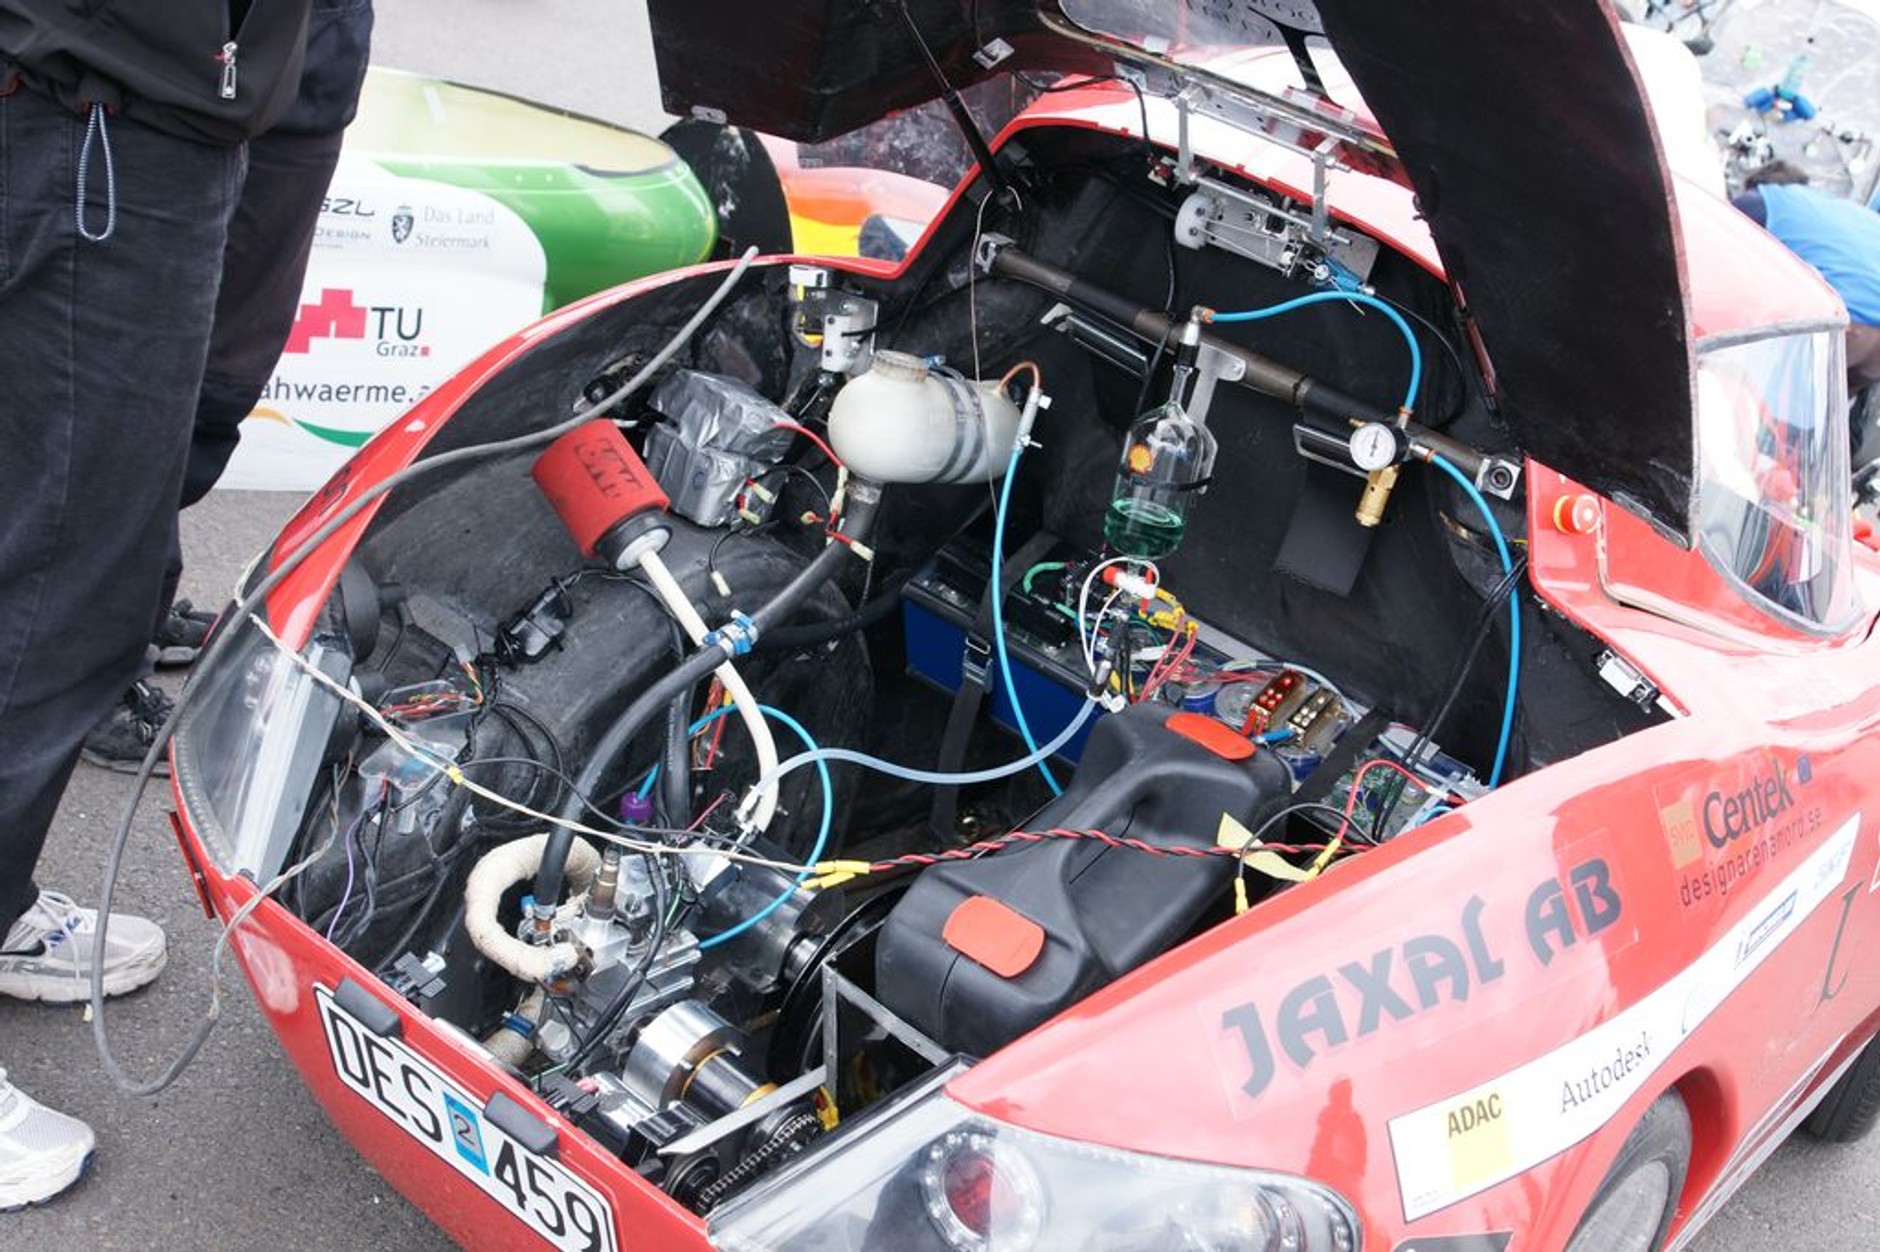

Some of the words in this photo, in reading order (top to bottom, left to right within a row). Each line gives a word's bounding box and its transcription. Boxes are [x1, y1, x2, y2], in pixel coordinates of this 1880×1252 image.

[424, 206, 451, 223] Das
[457, 208, 495, 225] Land
[415, 233, 490, 250] Steiermark
[371, 307, 422, 341] TU
[376, 341, 419, 357] Graz
[1703, 757, 1795, 848] Centek
[1222, 894, 1504, 1098] JAXAL
[1524, 857, 1622, 967] AB
[1560, 1031, 1651, 1114] Autodesk
[327, 1006, 443, 1143] DES
[453, 1114, 476, 1147] 2
[494, 1140, 602, 1252] 459
[1448, 1093, 1502, 1139] ADAC
